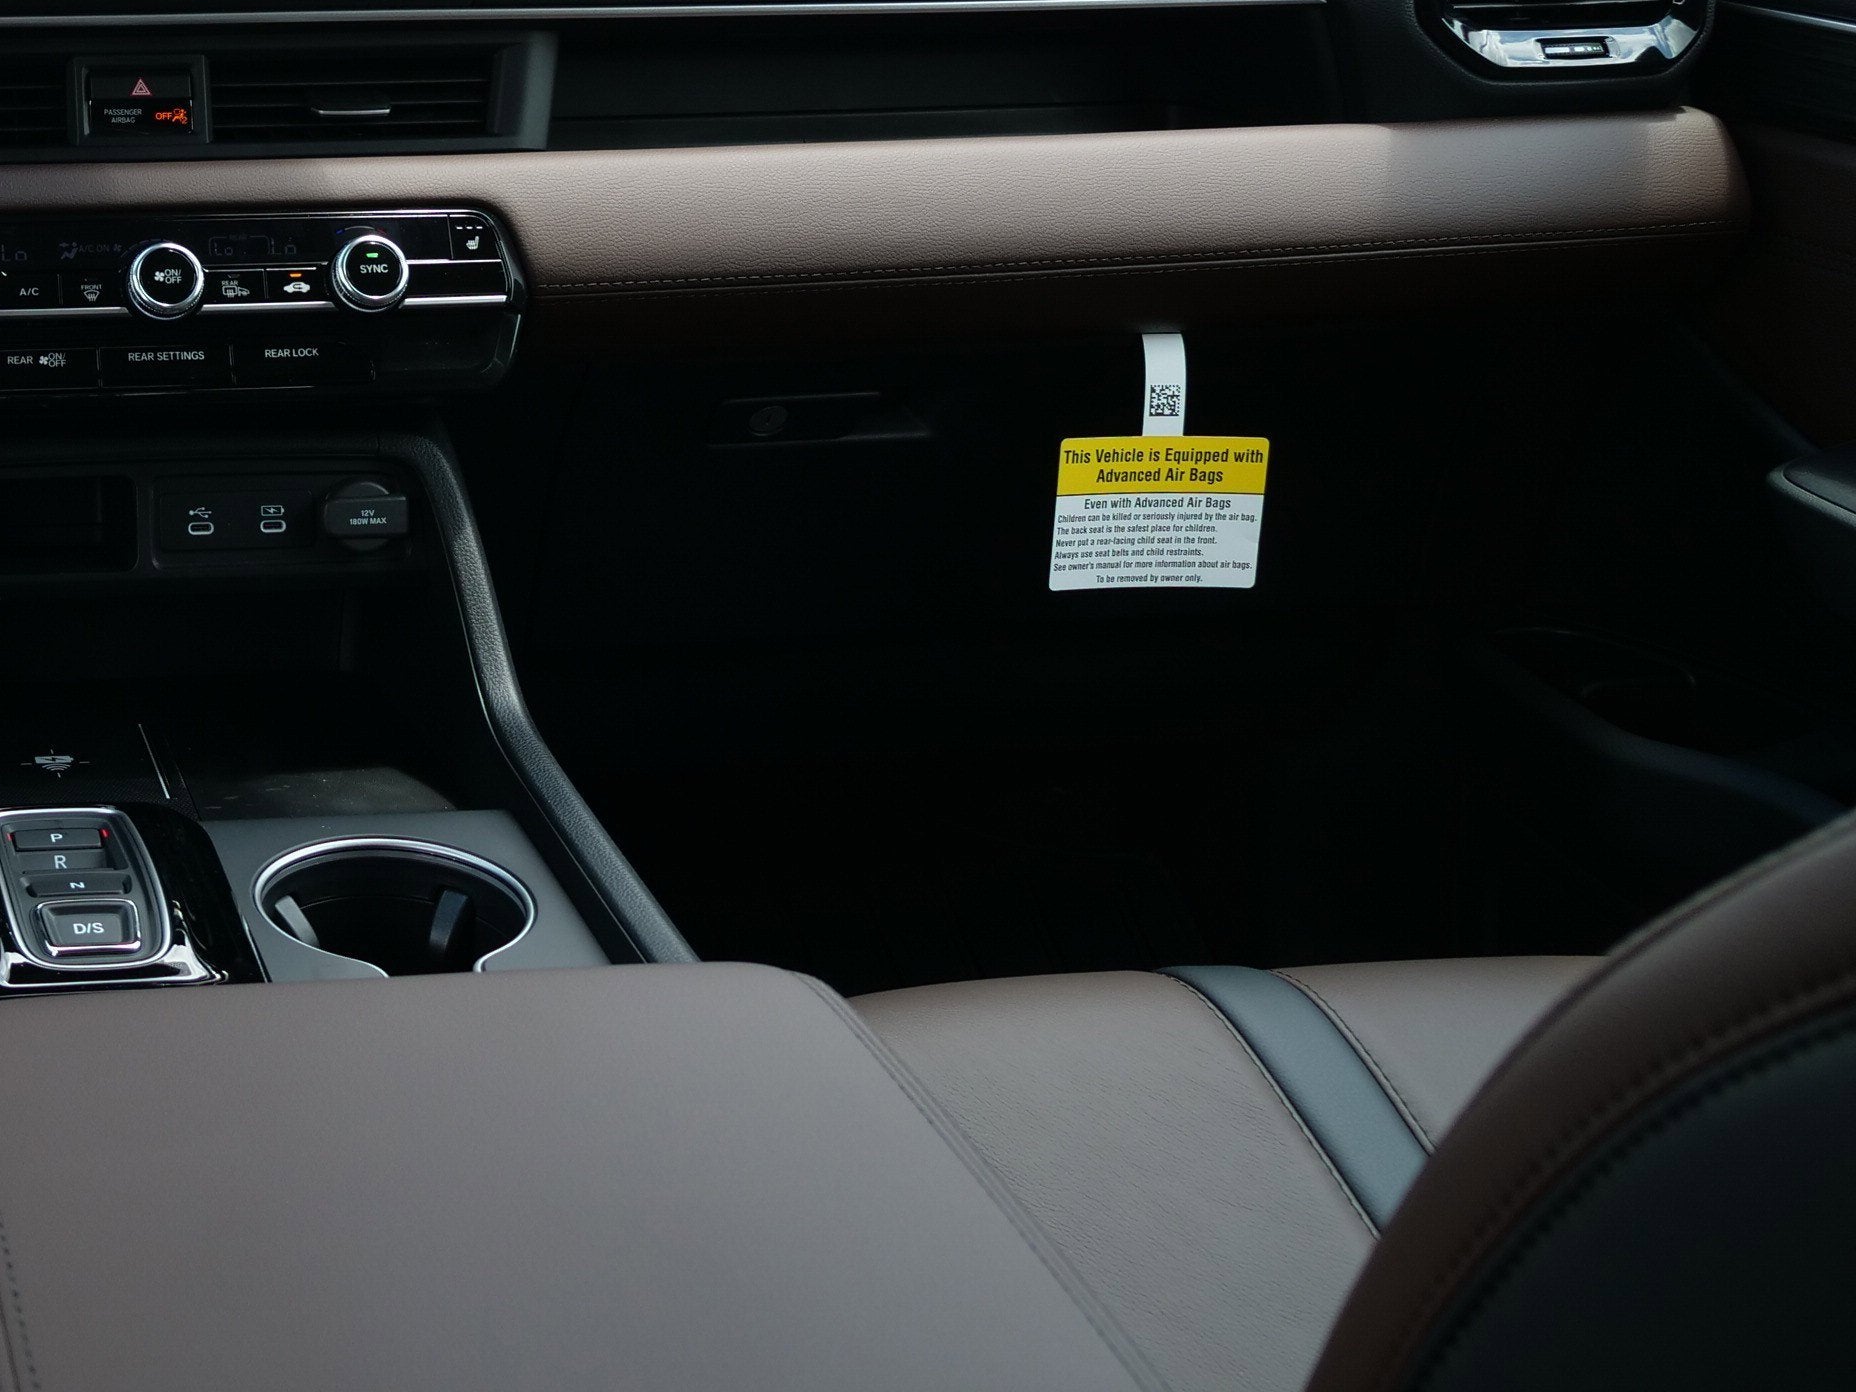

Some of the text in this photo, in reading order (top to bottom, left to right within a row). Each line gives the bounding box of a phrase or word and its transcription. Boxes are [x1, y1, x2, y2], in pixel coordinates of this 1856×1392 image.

[155, 112, 172, 120] OFF
[360, 264, 389, 274] SYNC
[164, 276, 182, 284] OFF
[19, 288, 39, 296] A/C
[128, 351, 205, 362] REAR SETTINGS
[264, 348, 319, 358] REAR LOCK
[7, 356, 34, 365] REAR
[1065, 448, 1263, 465] This Vehicle is Equipped with
[1096, 468, 1223, 484] Advanced Air Bags
[1084, 497, 1231, 510] Even with Advanced Air Bags
[1096, 575, 1104, 583] To
[1117, 574, 1148, 582] removed
[1150, 574, 1159, 583] by
[1185, 574, 1203, 583] only.
[50, 833, 63, 843] P
[54, 855, 67, 869] R
[73, 922, 105, 934] D/S
